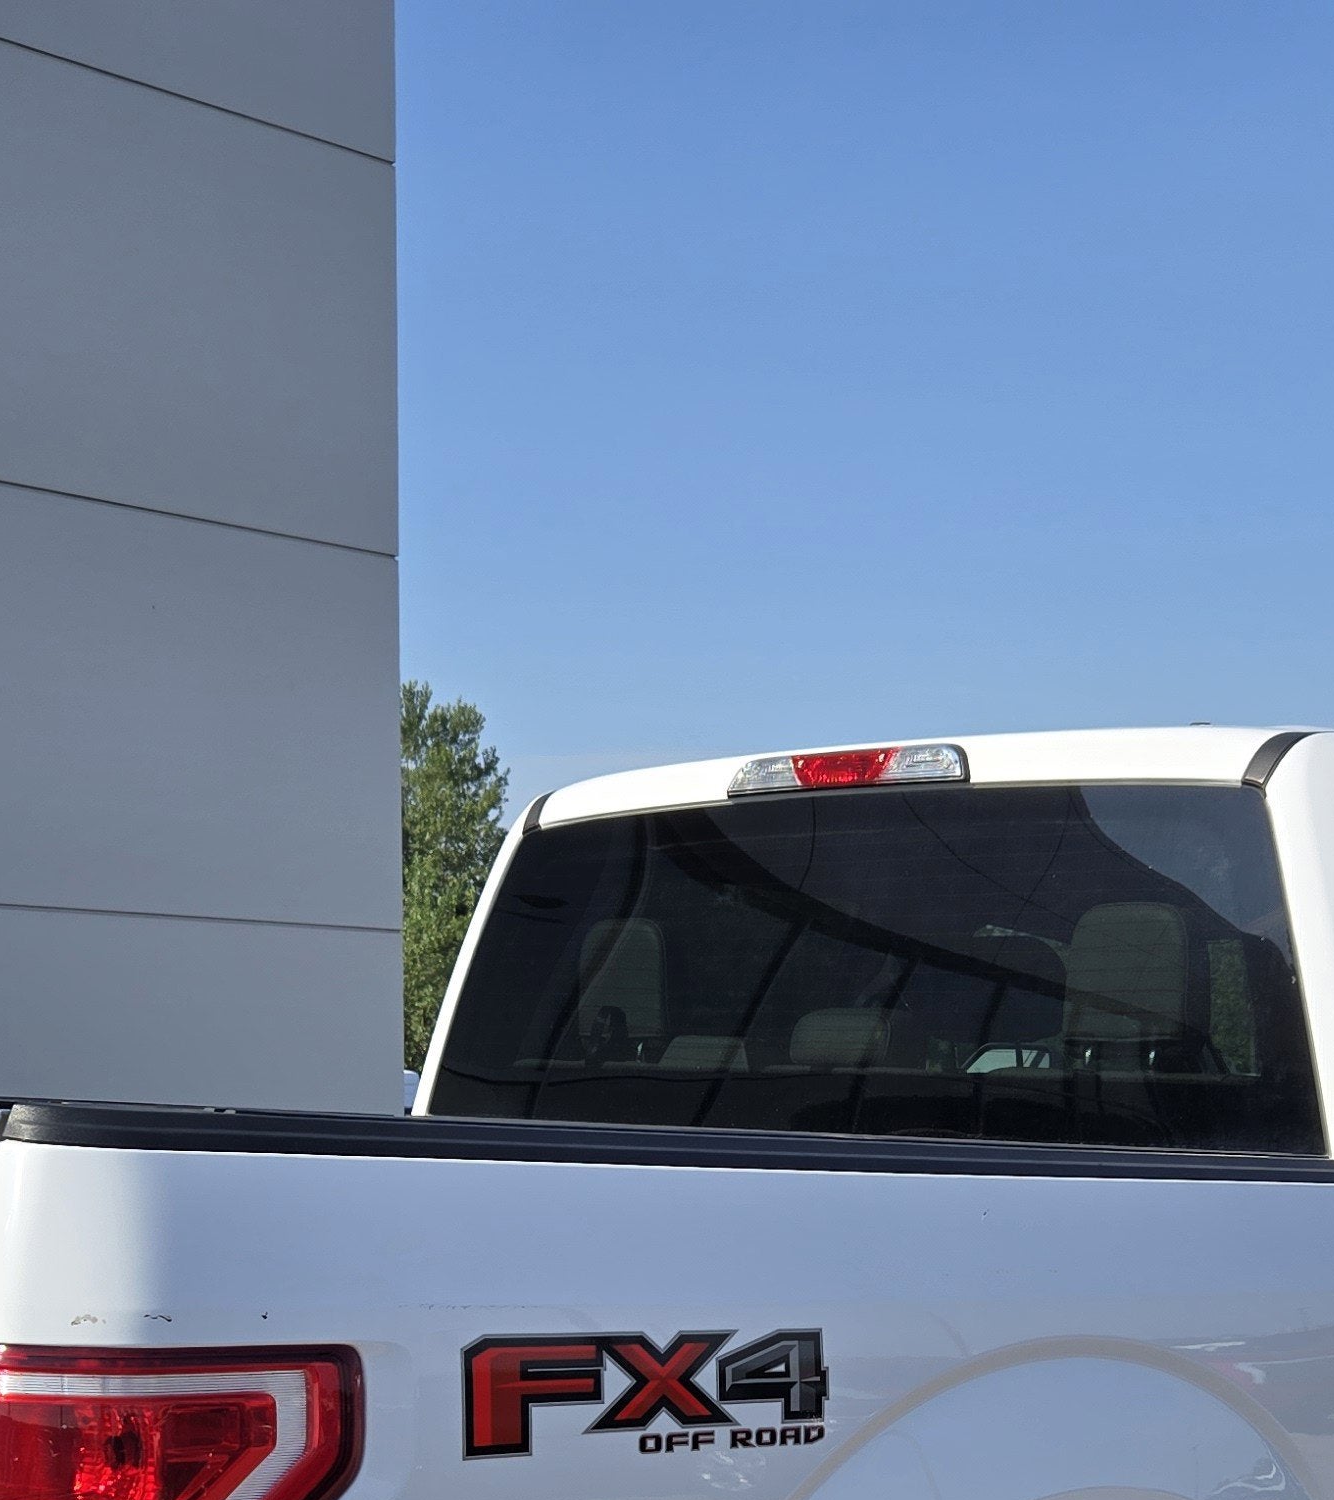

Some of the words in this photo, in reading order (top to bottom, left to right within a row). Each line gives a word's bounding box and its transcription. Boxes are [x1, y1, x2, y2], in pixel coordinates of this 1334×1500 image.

[460, 1328, 829, 1461] FX4
[639, 1430, 715, 1454] OFF
[729, 1425, 826, 1450] ROAD
